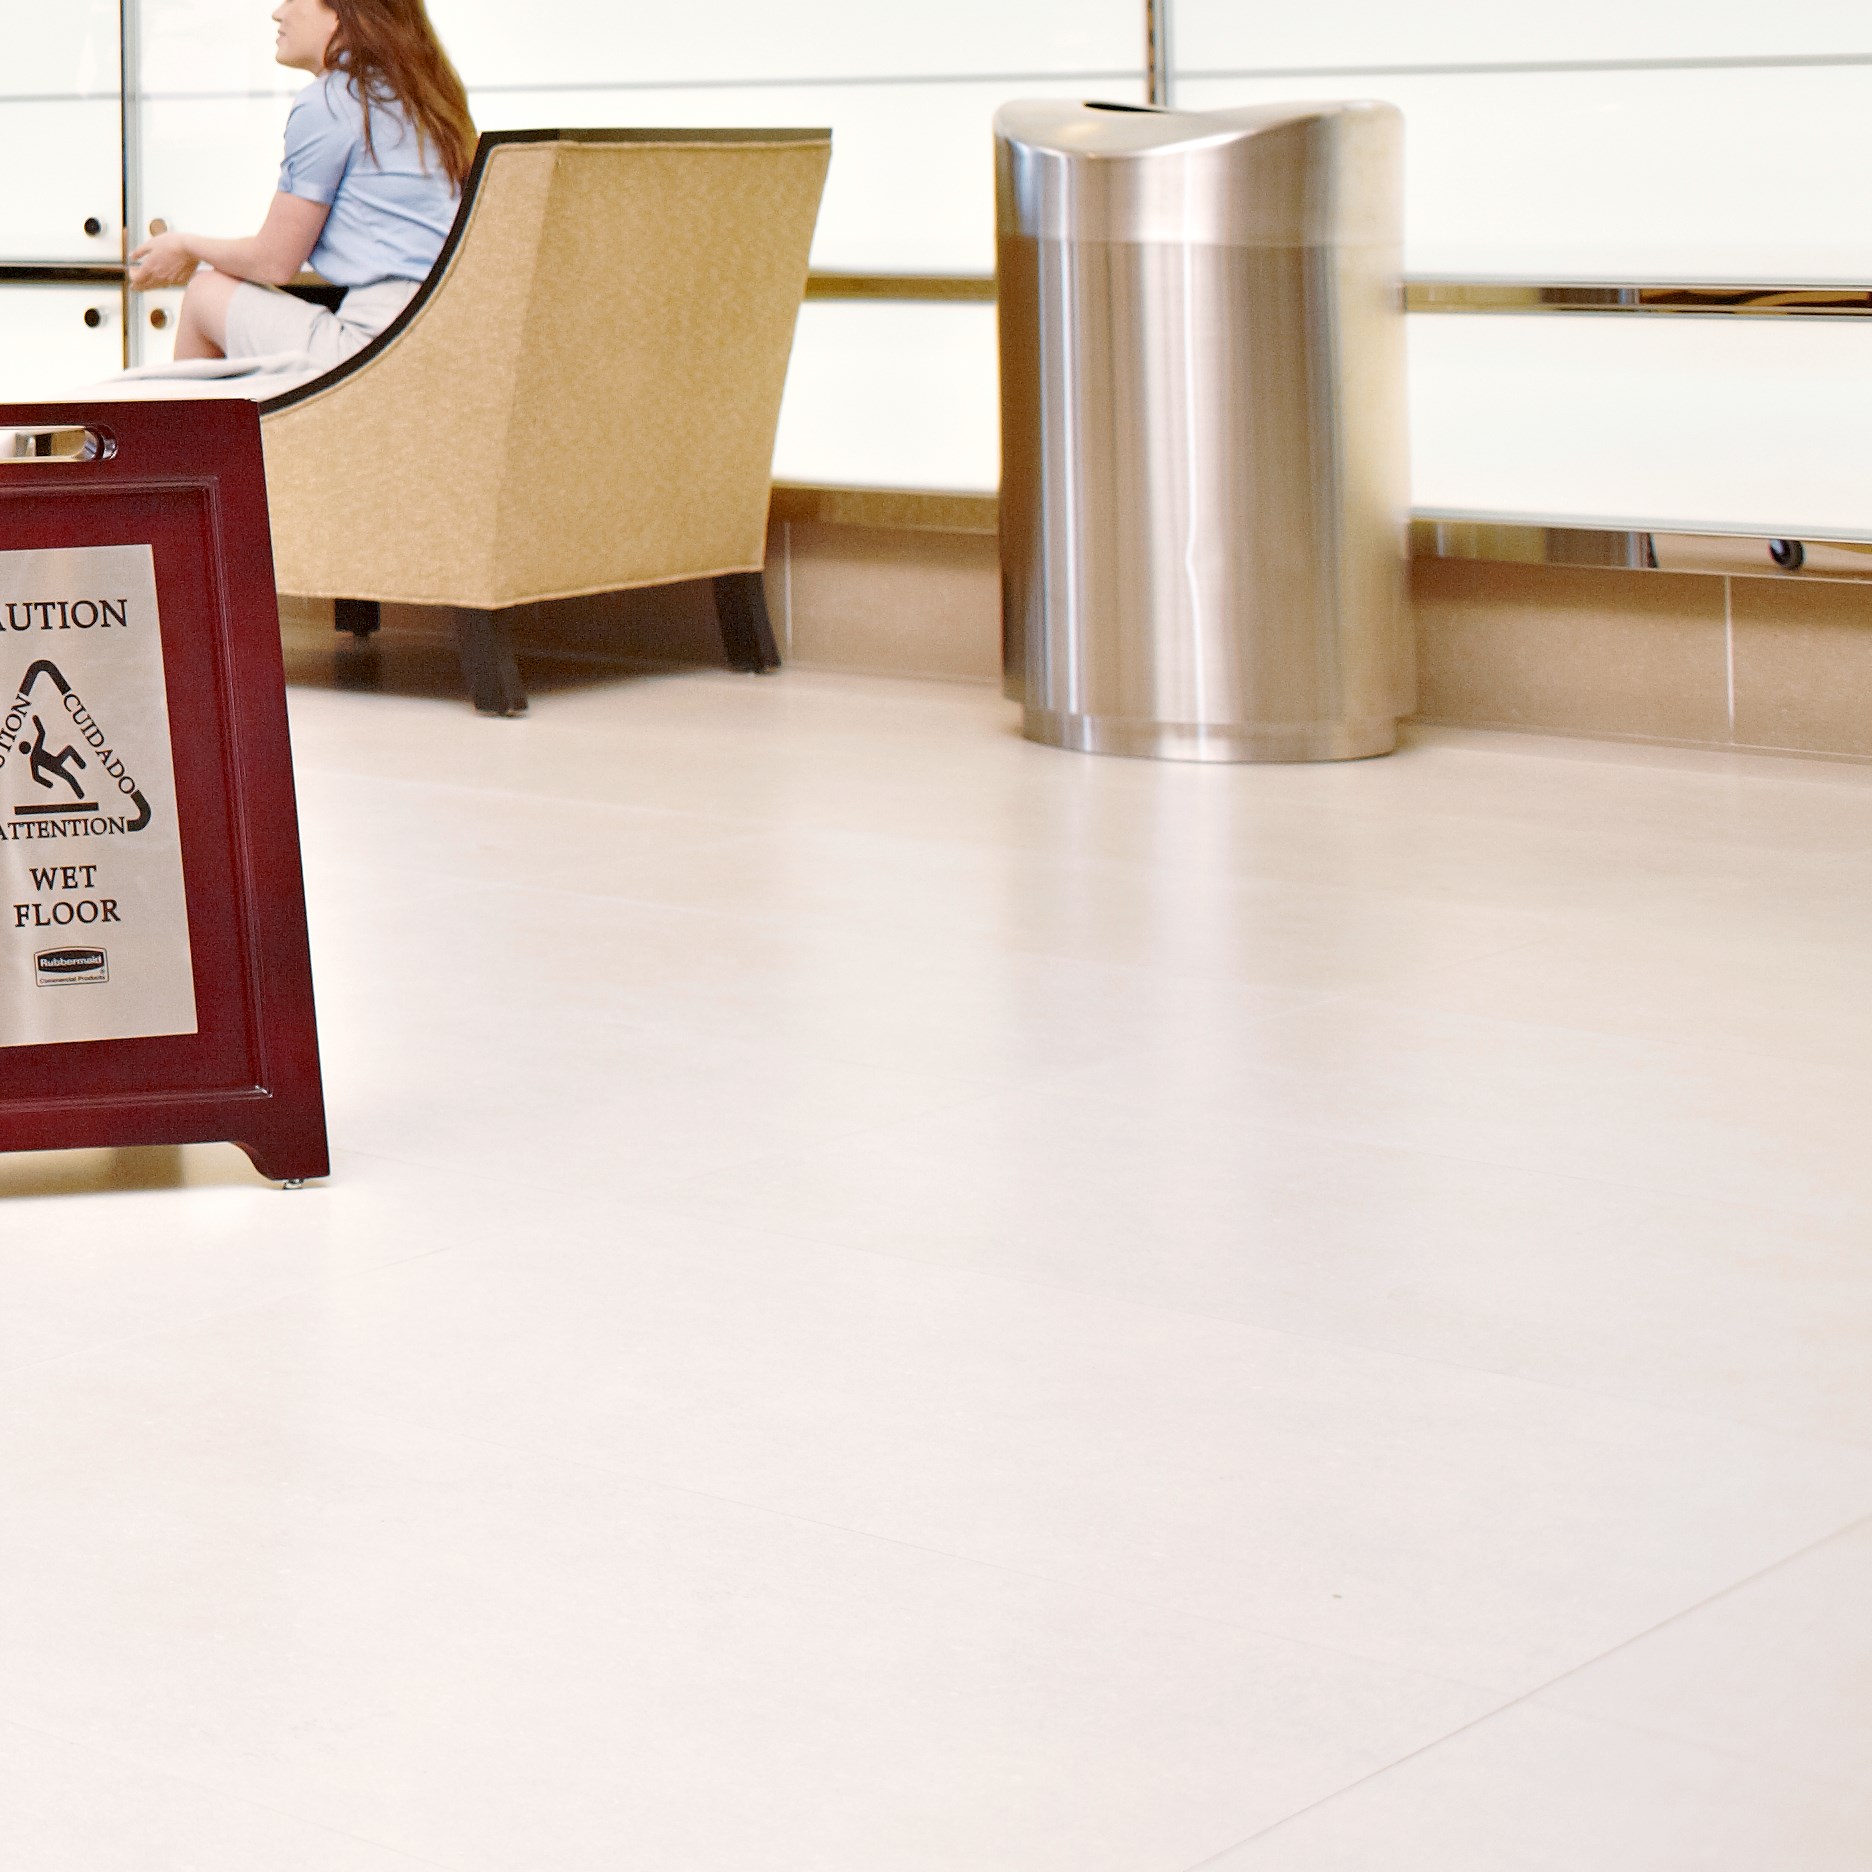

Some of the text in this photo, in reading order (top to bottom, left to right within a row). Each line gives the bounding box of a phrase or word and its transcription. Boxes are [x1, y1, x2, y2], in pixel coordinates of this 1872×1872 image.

[63, 692, 136, 795] CUIDADO
[29, 865, 97, 891] WET
[13, 899, 121, 927] FLOOR
[40, 955, 102, 967] Rubbermaid
